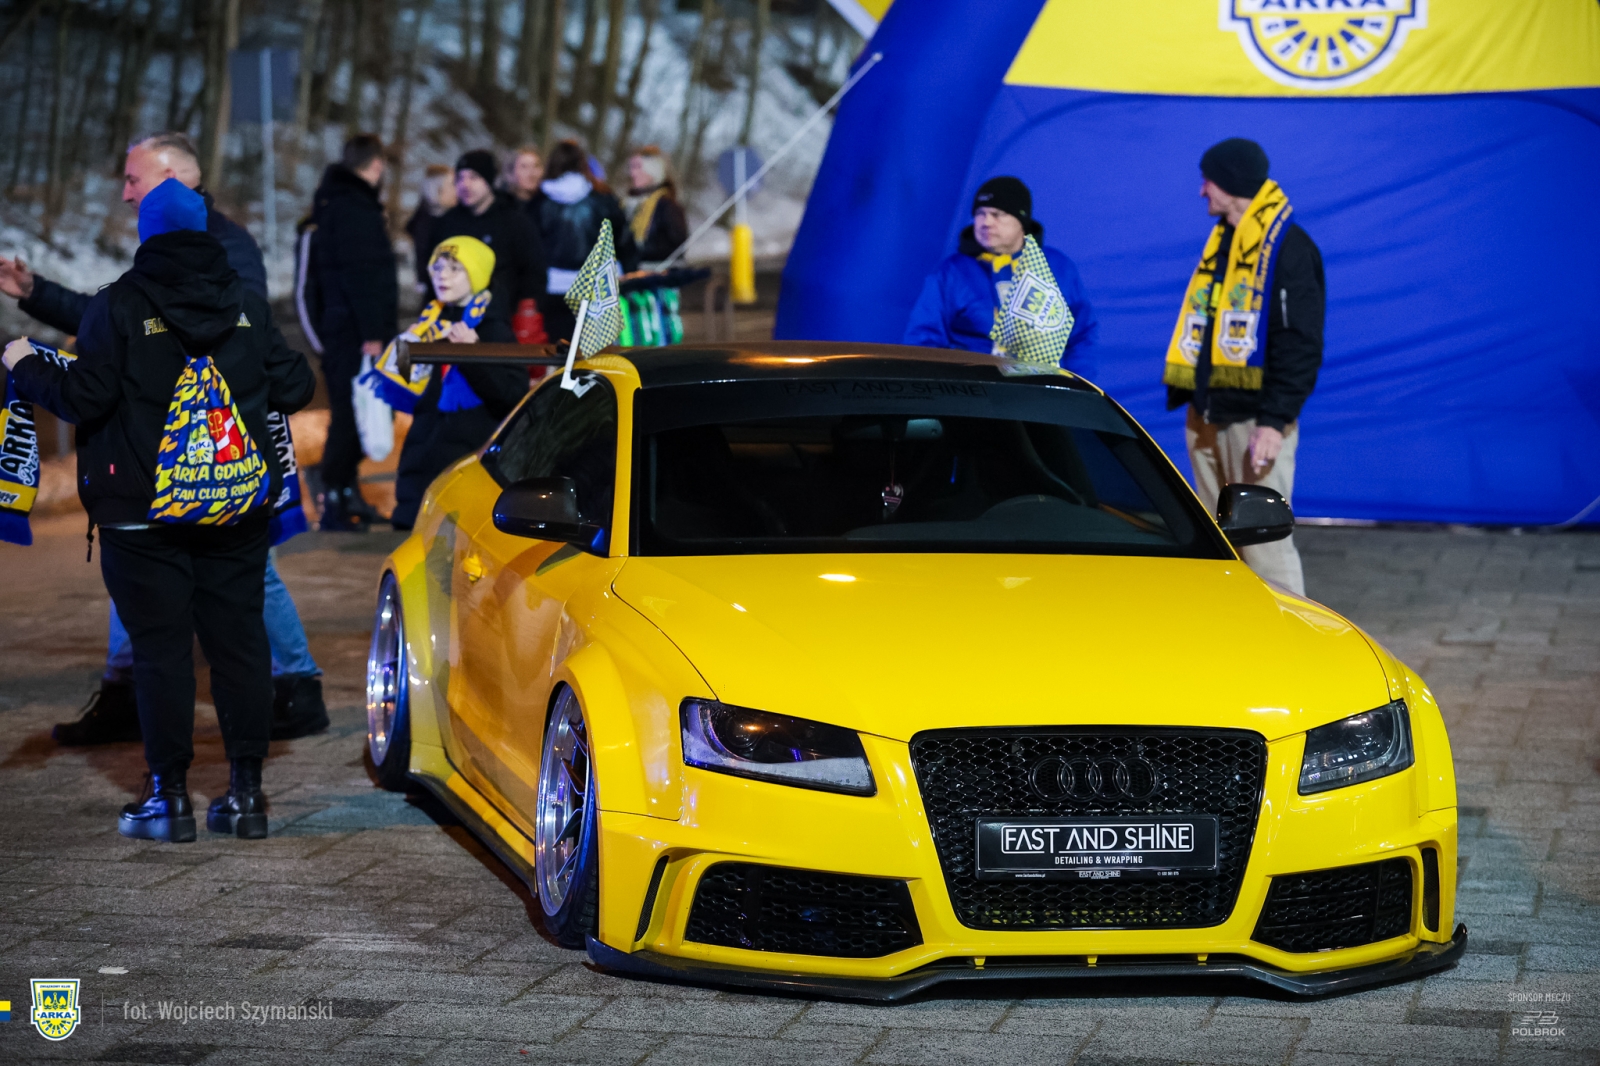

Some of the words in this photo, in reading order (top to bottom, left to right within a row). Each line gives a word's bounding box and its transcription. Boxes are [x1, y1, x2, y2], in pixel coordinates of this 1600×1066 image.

[784, 382, 838, 394] FAST
[851, 382, 903, 393] AND
[911, 382, 983, 396] SHINE
[0, 400, 36, 476] ARKA
[173, 464, 210, 482] ARKA
[214, 453, 261, 480] GDYNIA
[172, 487, 196, 500] FAN
[198, 487, 227, 499] CLUB
[230, 477, 259, 496] RUMIA
[1005, 828, 1059, 853] FAST
[1066, 828, 1118, 850] AND
[1124, 824, 1190, 849] SHINE
[1054, 855, 1093, 865] DETAILING
[1095, 856, 1101, 864] &
[1103, 855, 1143, 864] WRAPPING
